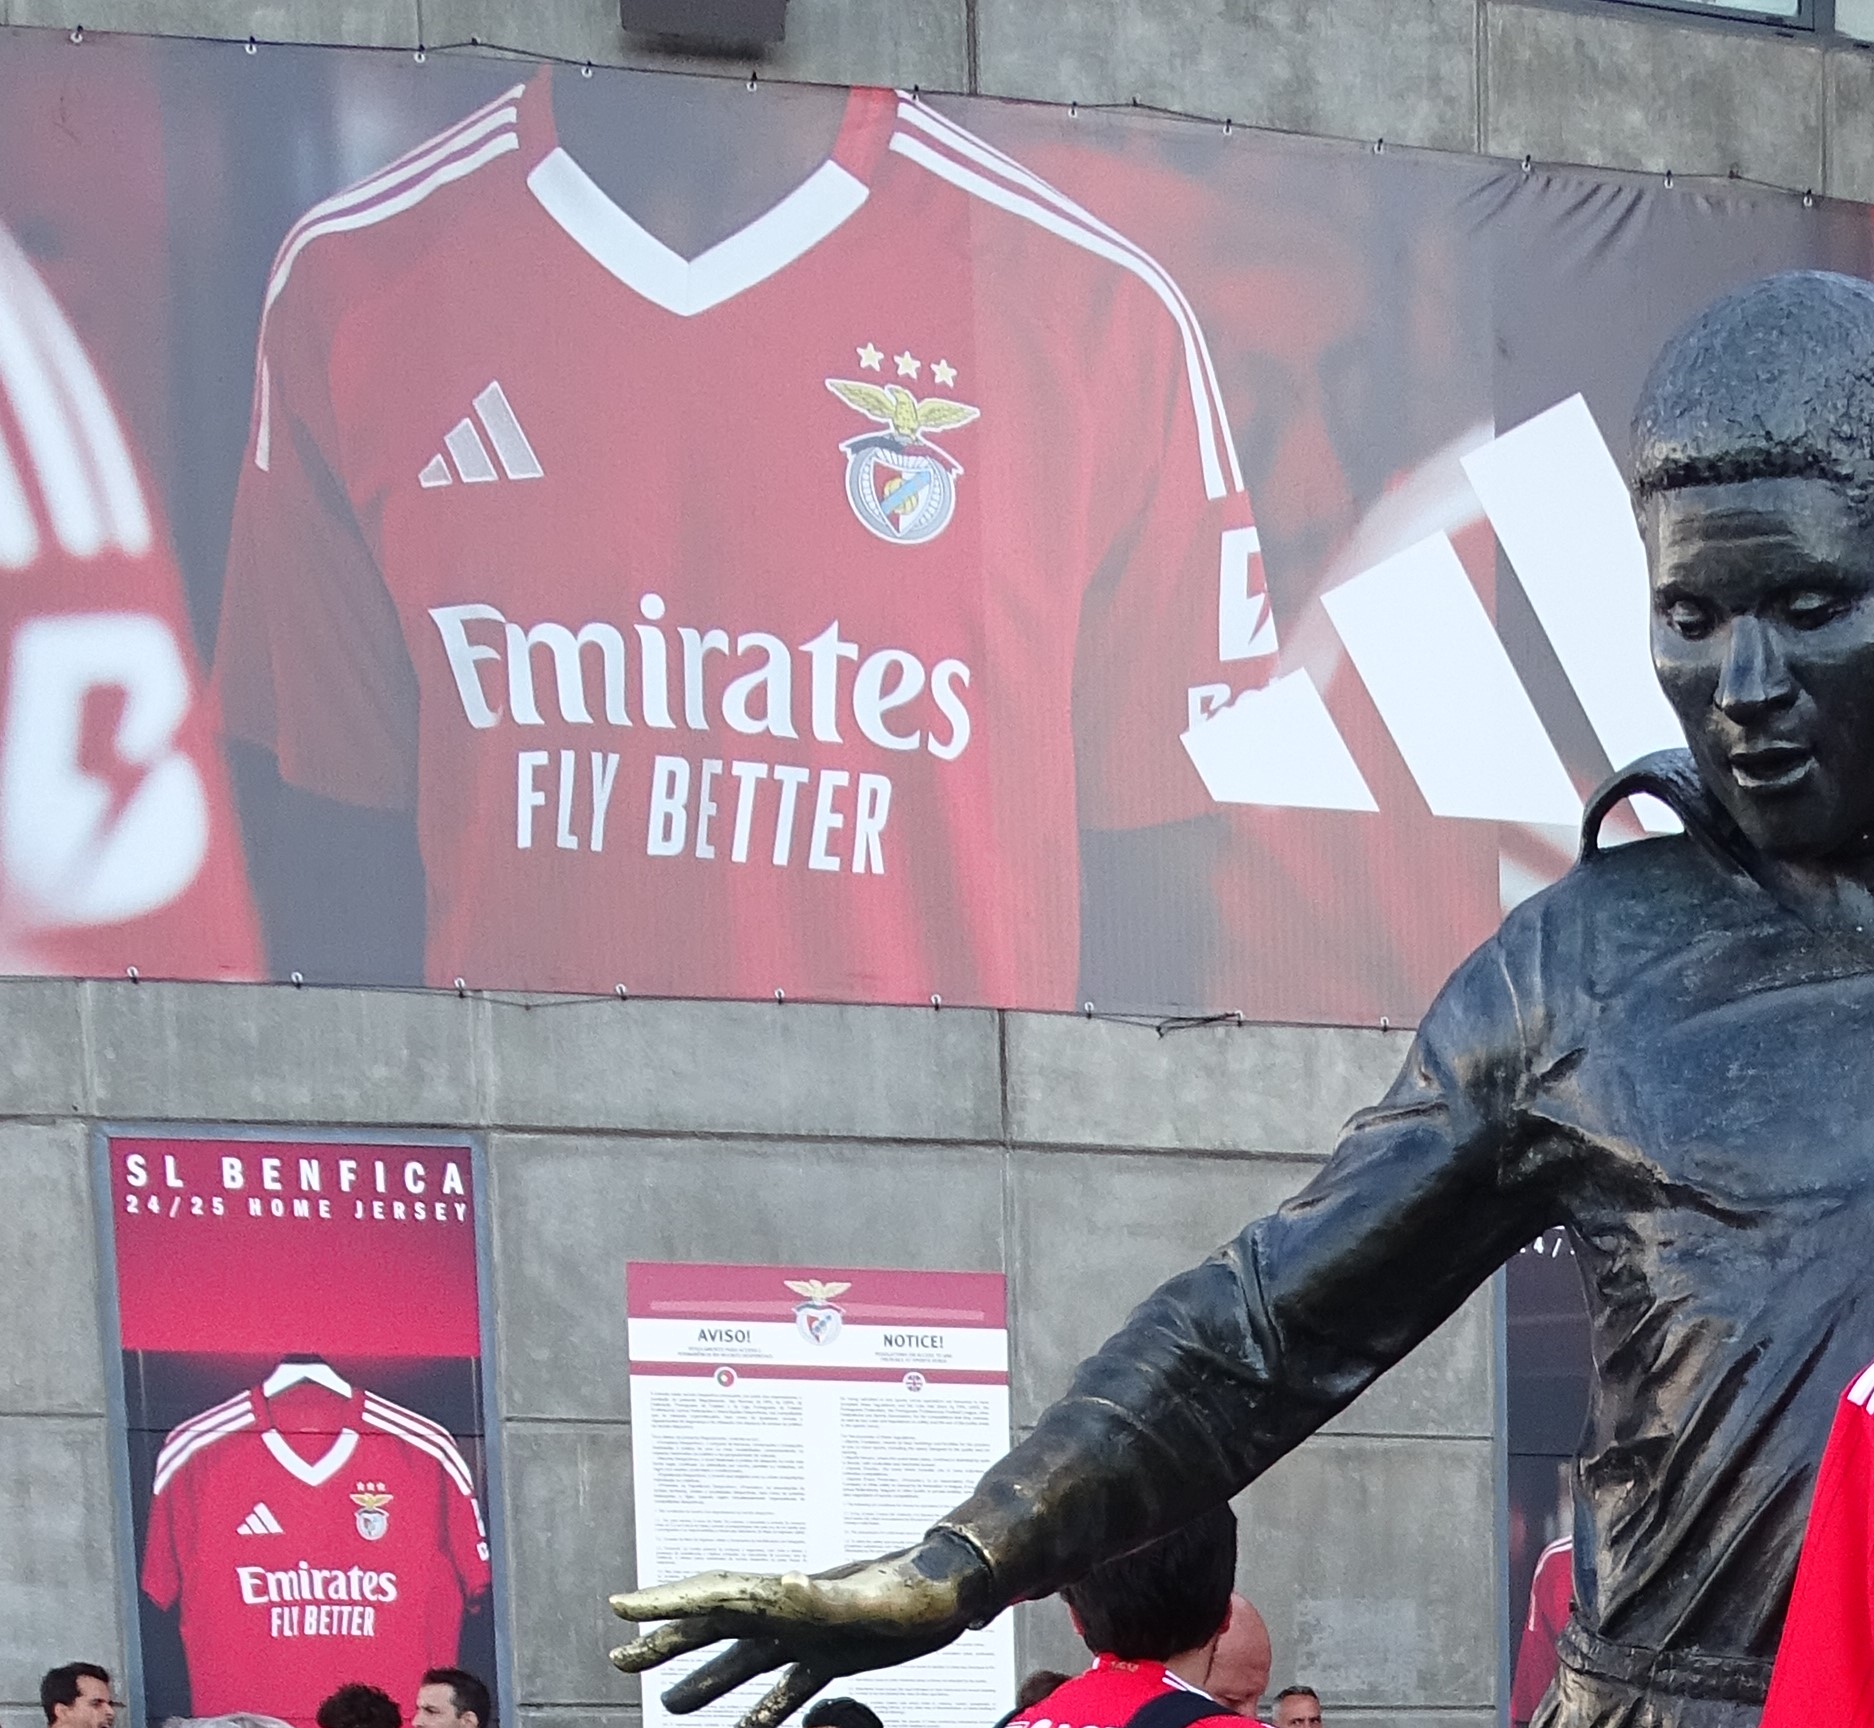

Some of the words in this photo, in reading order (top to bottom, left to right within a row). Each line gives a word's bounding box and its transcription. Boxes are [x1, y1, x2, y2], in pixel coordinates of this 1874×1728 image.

[428, 594, 971, 760] Emirates
[518, 750, 619, 851] FLY
[647, 756, 892, 874] BETTER
[127, 1154, 183, 1187] SL
[222, 1157, 464, 1194] BENFICA
[127, 1195, 224, 1217] 24/25
[249, 1198, 330, 1218] HOME
[355, 1201, 466, 1221] JERSEY
[698, 1329, 750, 1343] AVISO!
[884, 1335, 943, 1348] NOTICE!
[237, 1561, 397, 1604] Emirates
[272, 1606, 299, 1637] FLY
[304, 1606, 374, 1636] BETTER
